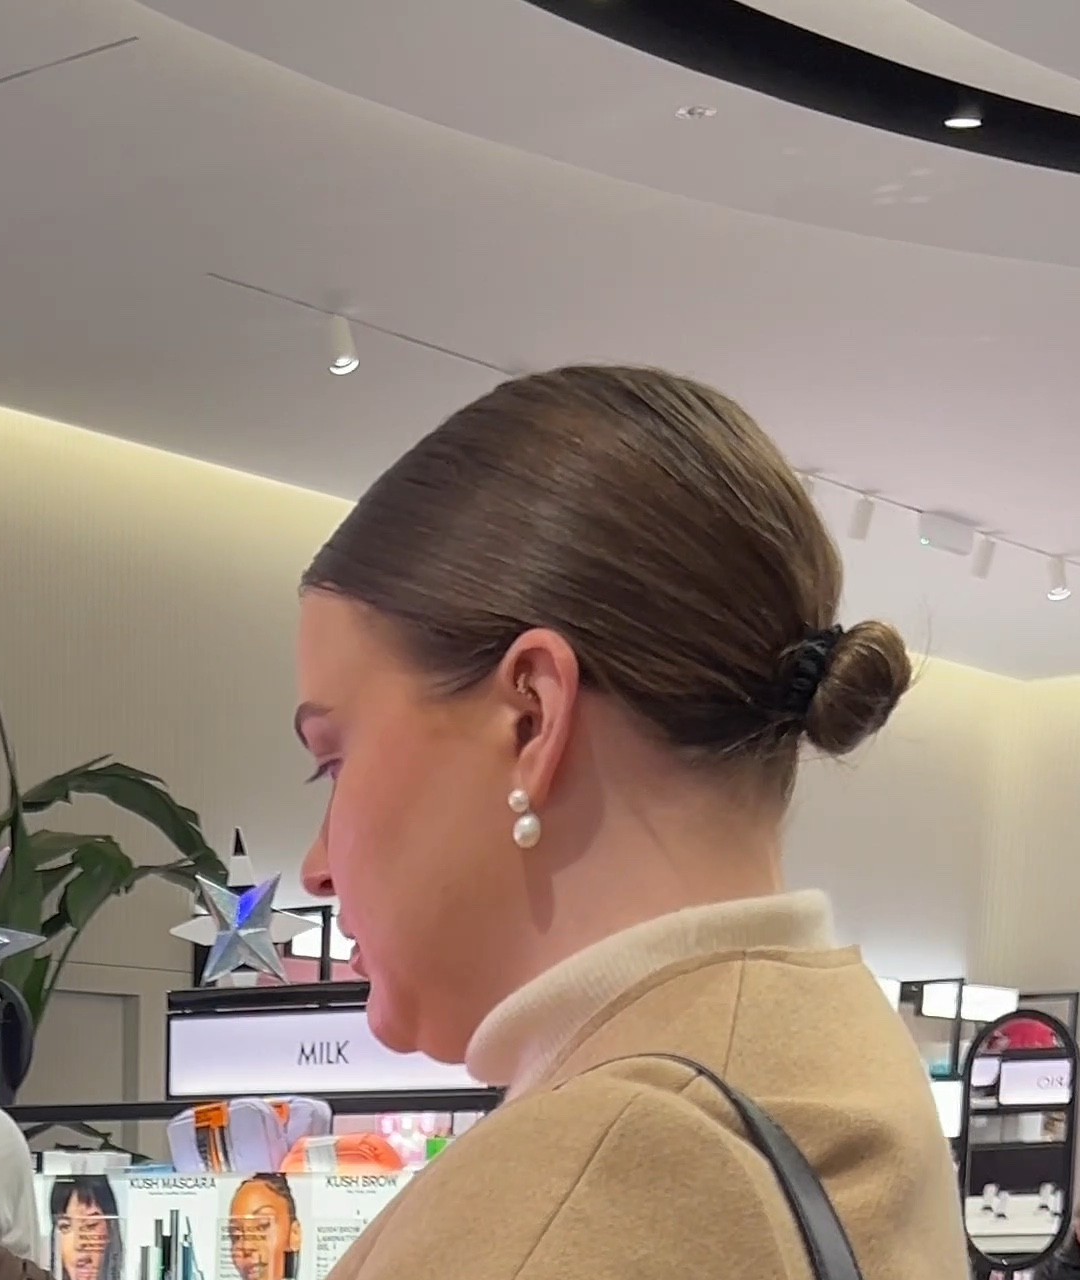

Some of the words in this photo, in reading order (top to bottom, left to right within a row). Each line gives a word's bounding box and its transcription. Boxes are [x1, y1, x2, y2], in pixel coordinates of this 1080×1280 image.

[297, 1040, 351, 1066] MILK
[129, 1177, 160, 1190] KUSH
[161, 1177, 217, 1190] MASCARA
[326, 1176, 360, 1188] KUSH
[362, 1176, 398, 1188] BROW
